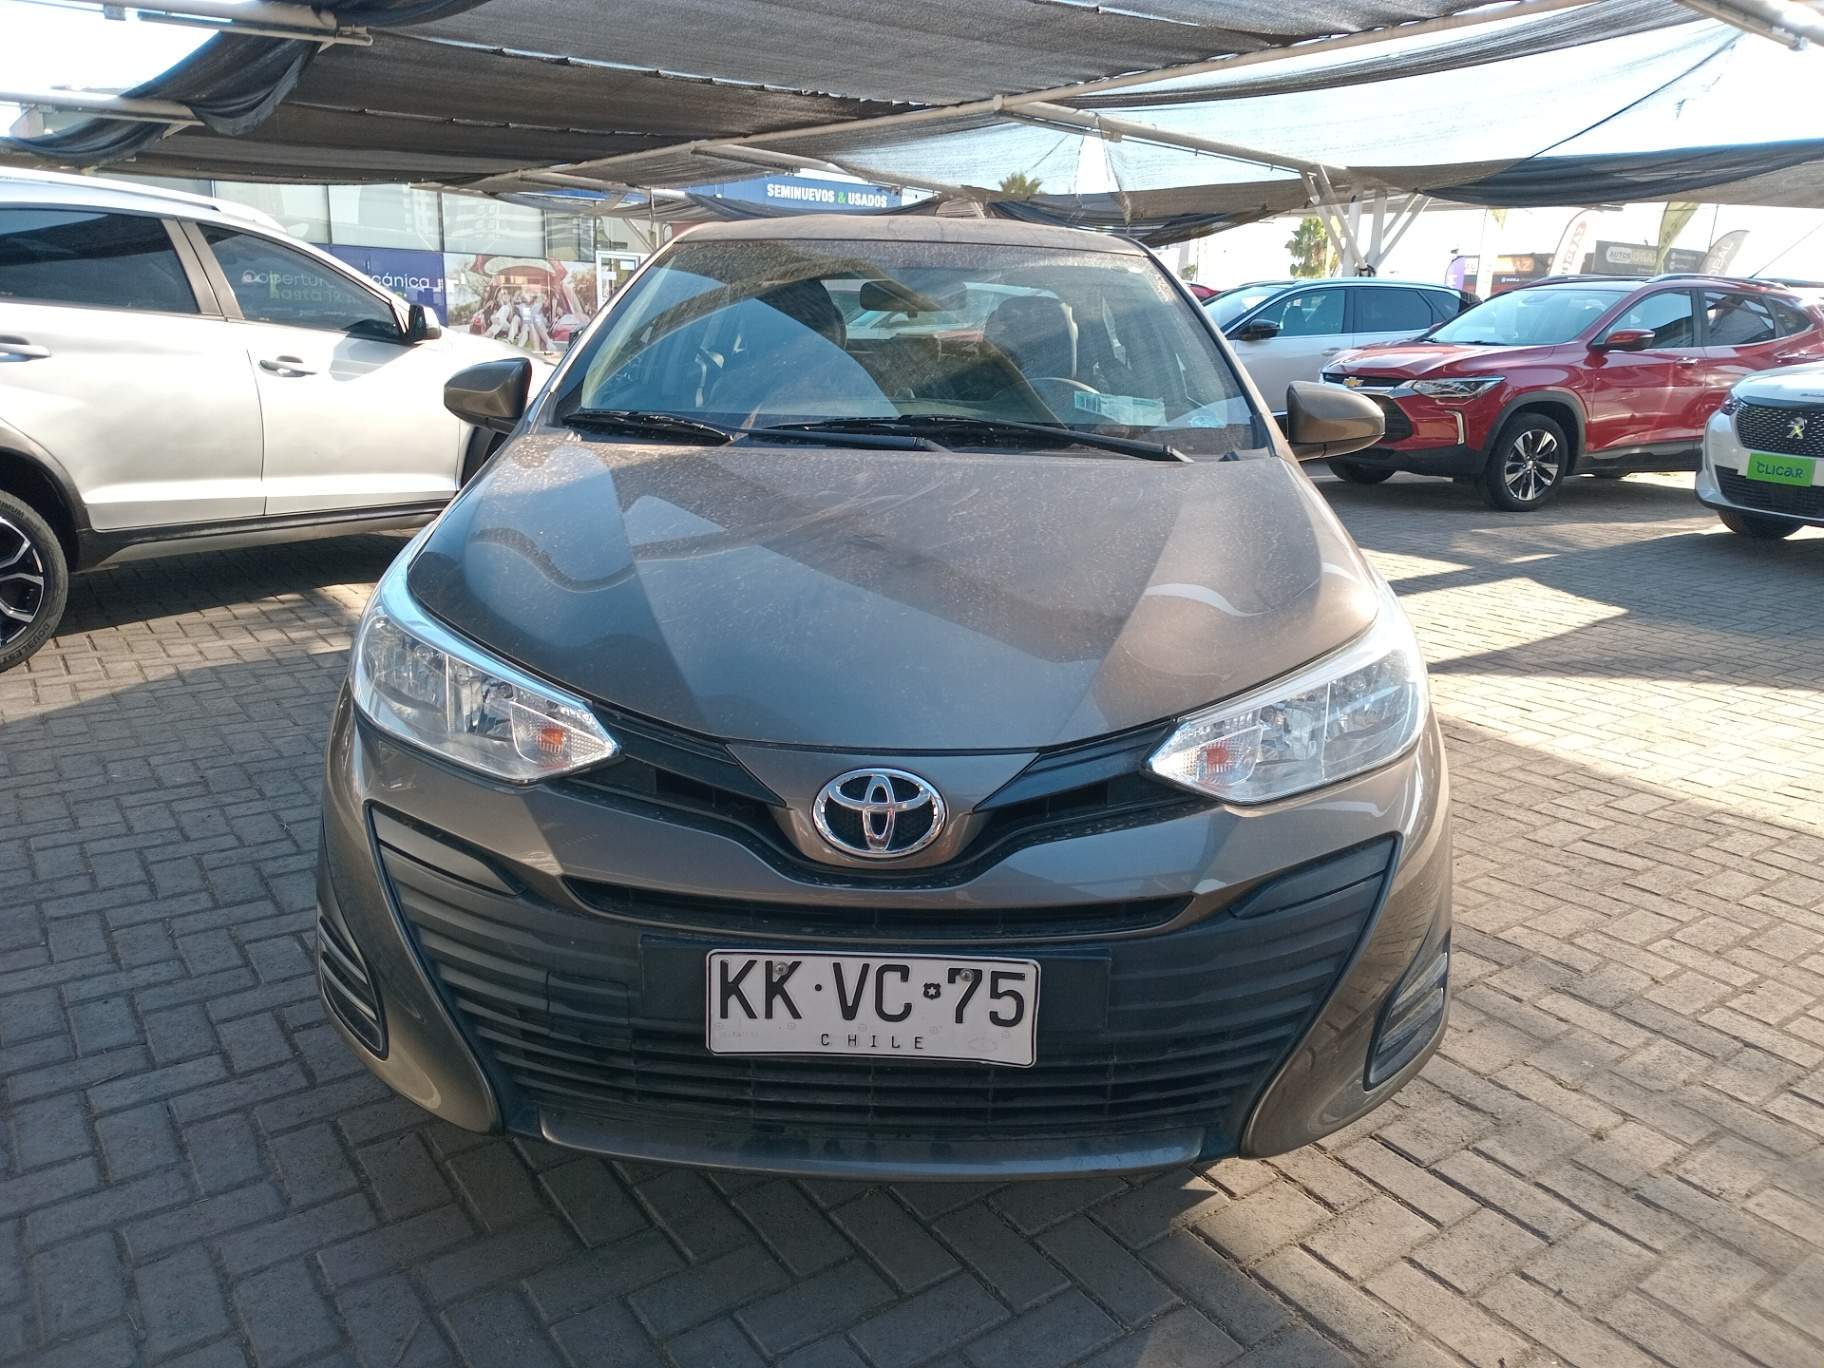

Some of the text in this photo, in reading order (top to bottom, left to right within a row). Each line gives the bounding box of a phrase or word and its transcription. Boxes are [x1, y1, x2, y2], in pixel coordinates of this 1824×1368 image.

[767, 183, 887, 208] SEMINUEVOS & USADOS
[371, 272, 430, 289] cánica
[820, 1033, 924, 1050] CHILE
